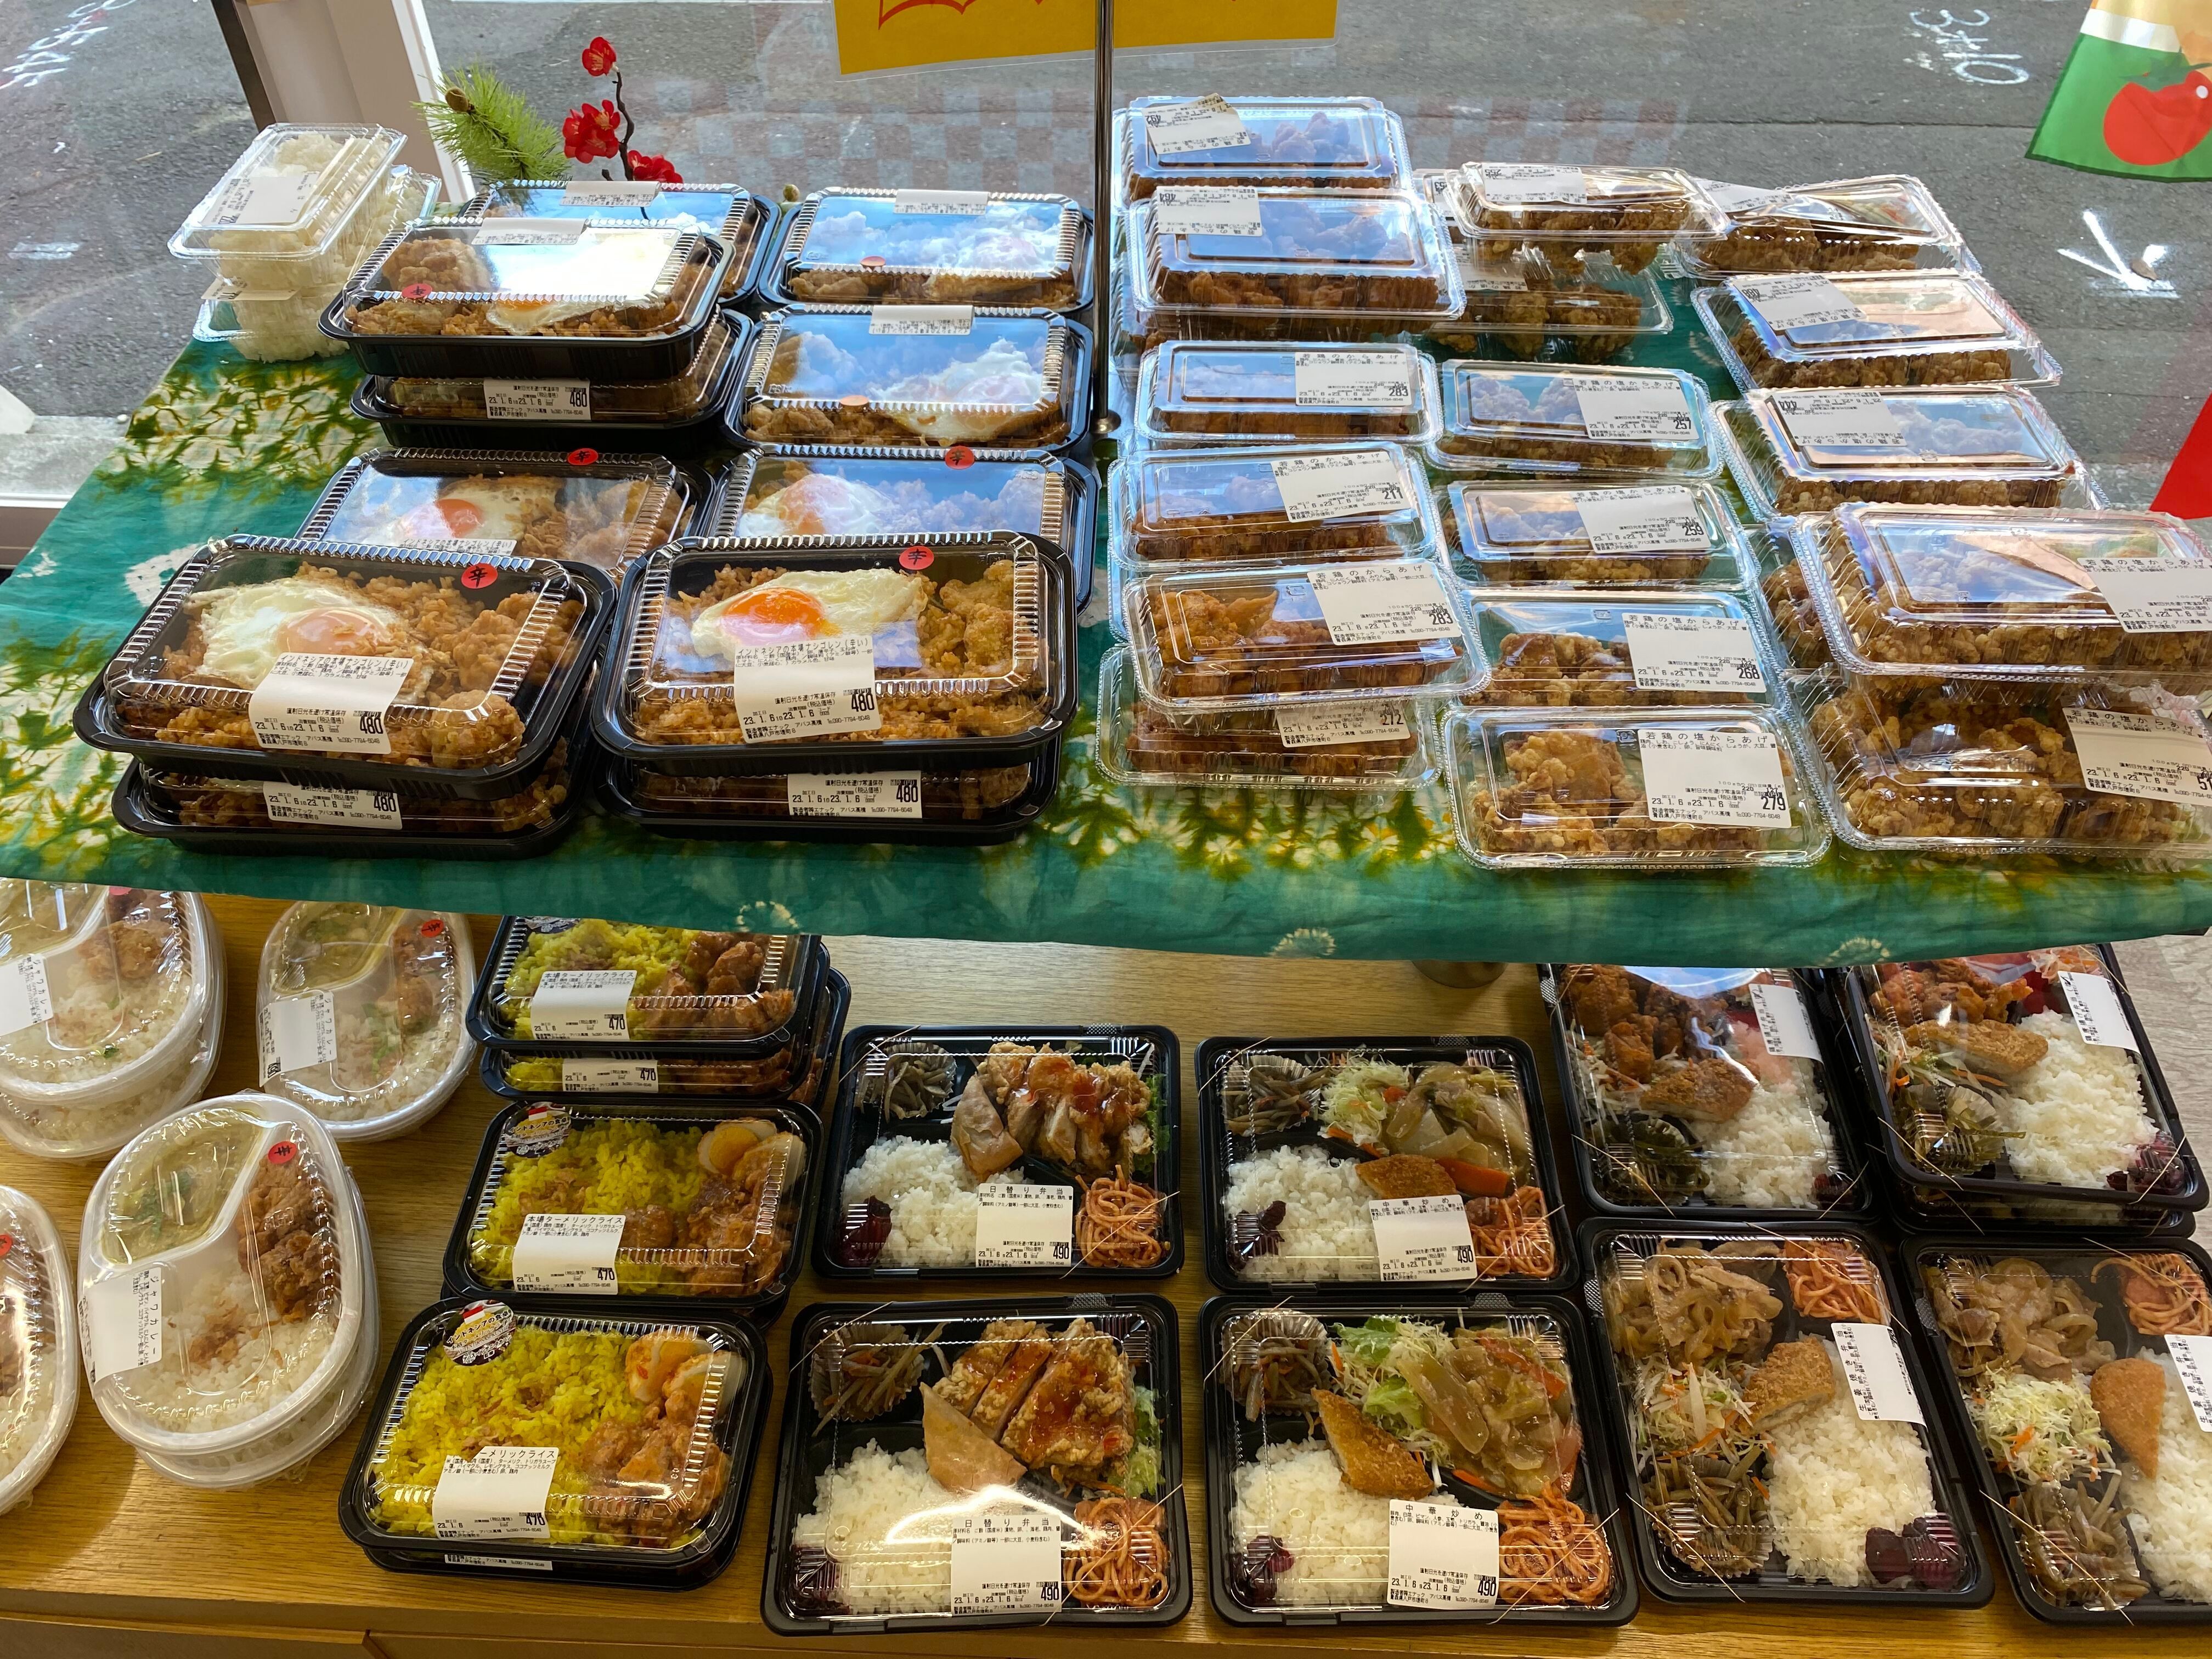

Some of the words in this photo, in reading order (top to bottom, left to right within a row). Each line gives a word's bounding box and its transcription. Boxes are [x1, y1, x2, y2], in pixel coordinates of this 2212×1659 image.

[570, 392, 588, 407] 480
[1674, 420, 1691, 429] 257
[1384, 489, 1403, 499] 211
[1683, 525, 1704, 535] 259
[1430, 613, 1453, 625] 283
[1737, 668, 1759, 679] 268
[851, 693, 874, 712] 480
[360, 715, 383, 734] 480
[1383, 714, 1403, 725] 272
[1646, 732, 1767, 743] 若鶏の塩からあげ
[896, 785, 918, 803] 480
[374, 797, 396, 812] 480
[1761, 797, 1785, 811] 279
[610, 1018, 625, 1030] 470
[640, 1070, 656, 1080] 470
[990, 1186, 1063, 1194] 日替り弁当
[1383, 1198, 1448, 1206] 中華炒め
[1053, 1246, 1069, 1259] 490
[1458, 1249, 1473, 1263] 490
[598, 1271, 614, 1280] 470
[150, 1276, 159, 1355] ジャワカレー
[1406, 1504, 1482, 1520] 中華炒め
[966, 1517, 1049, 1527] 日替り弁当
[1041, 1587, 1059, 1600] 490
[1478, 1581, 1496, 1596] 490
